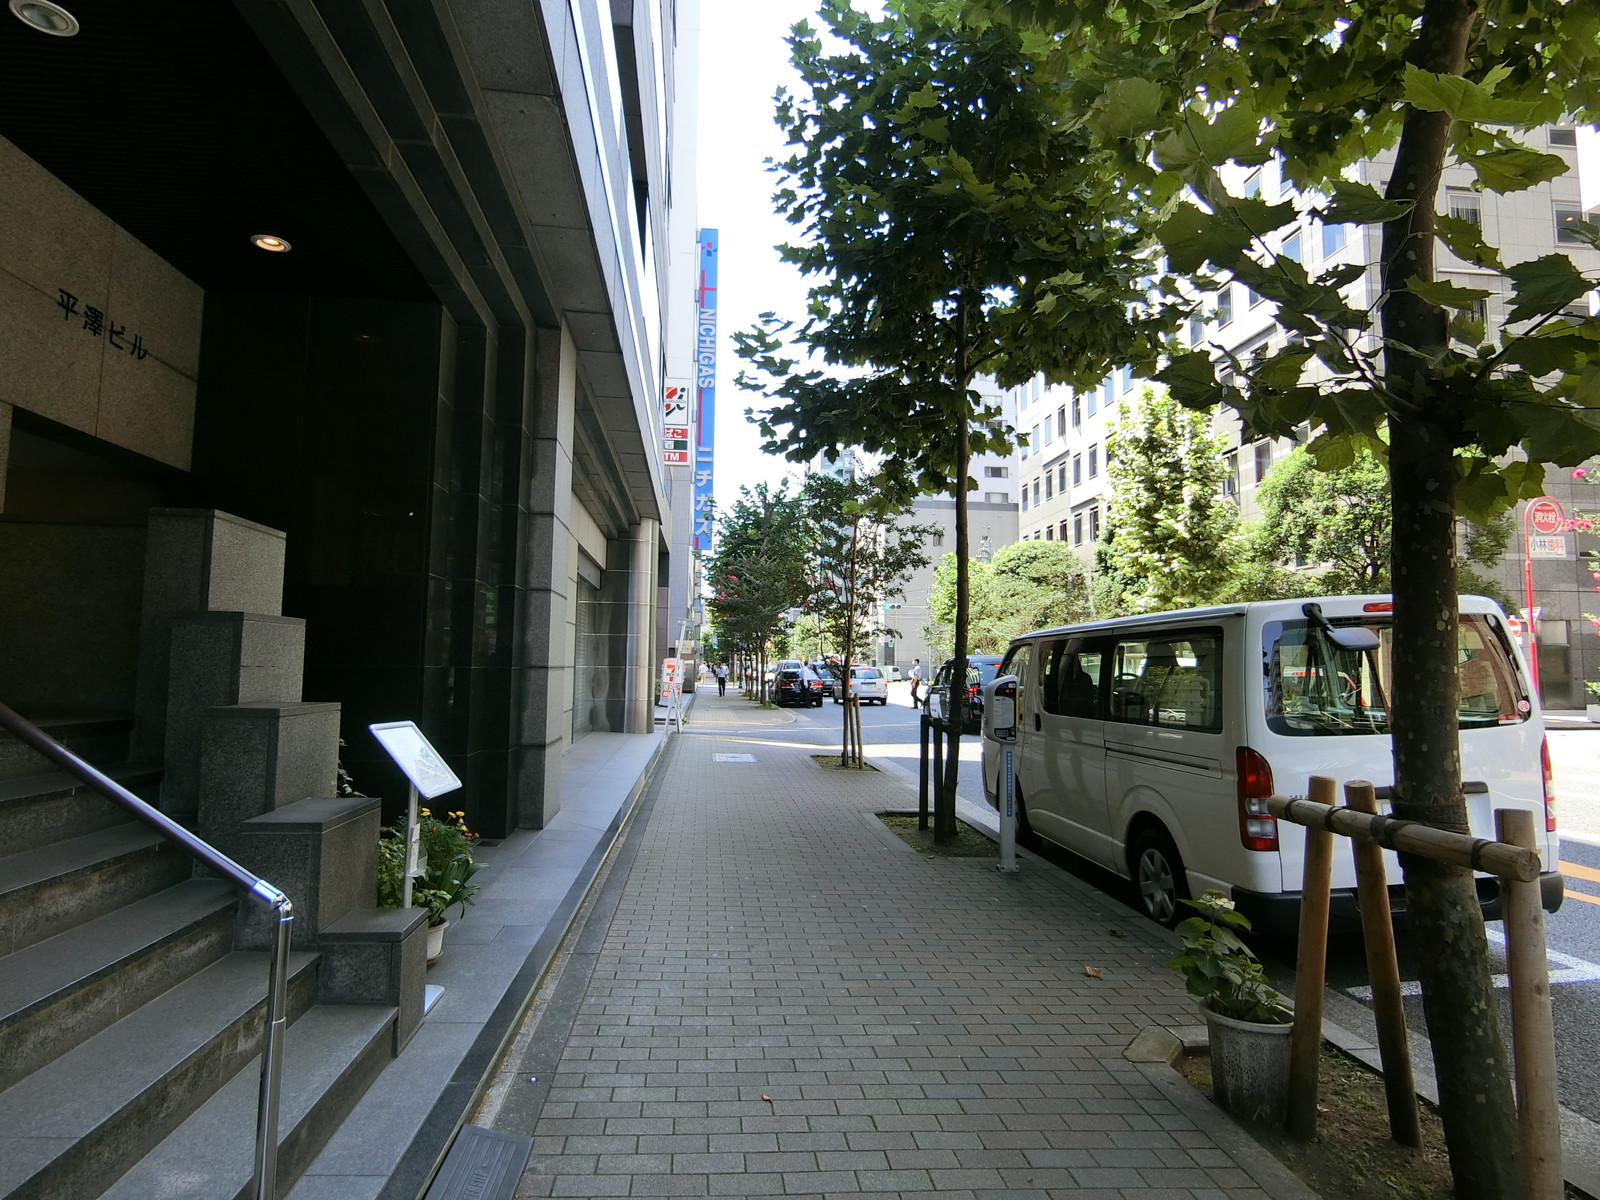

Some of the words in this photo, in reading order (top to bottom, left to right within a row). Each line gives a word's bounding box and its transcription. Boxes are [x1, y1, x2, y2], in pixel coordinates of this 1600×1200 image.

[56, 287, 149, 360] 平澤ビル
[698, 308, 717, 390] NICHIGAS
[695, 446, 713, 537] ニチガス
[1534, 511, 1556, 523] 消火栓
[1531, 539, 1563, 551] 小林歯科
